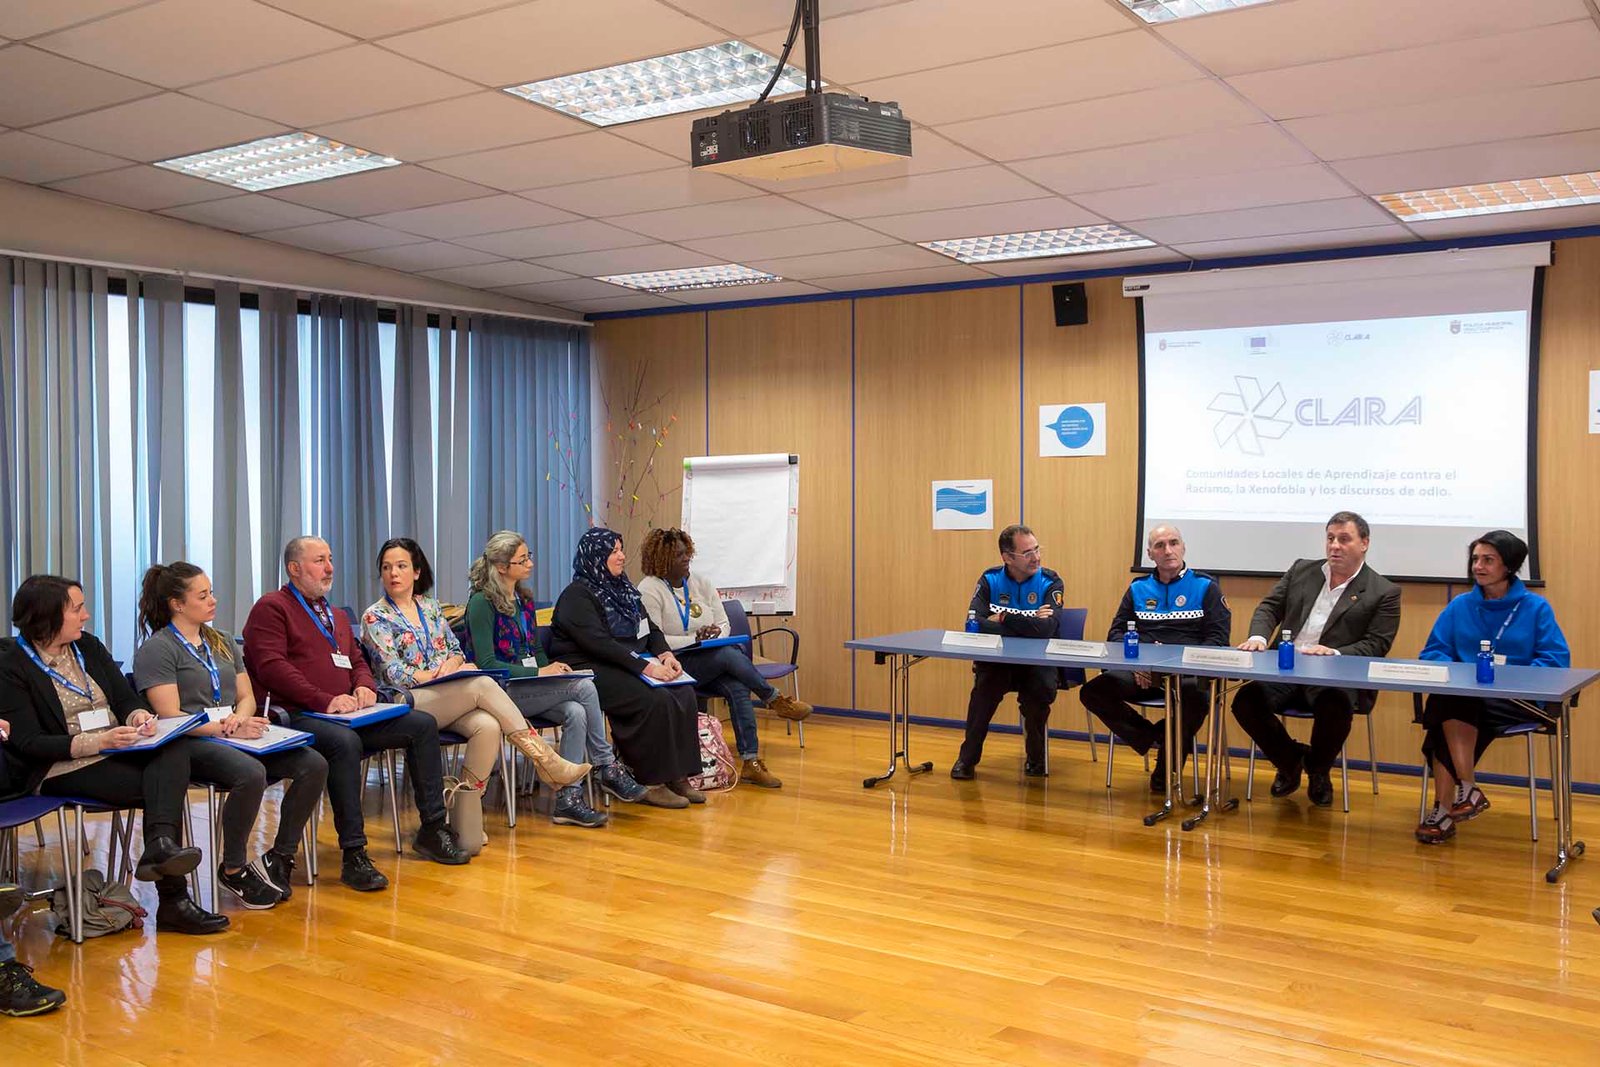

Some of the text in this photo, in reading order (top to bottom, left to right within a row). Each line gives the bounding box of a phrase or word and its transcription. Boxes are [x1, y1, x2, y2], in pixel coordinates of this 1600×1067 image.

[1295, 395, 1422, 427] CLARA
[1185, 468, 1457, 481] Comunidades Locales de Aprendizaje contra el
[1185, 483, 1453, 497] Racismo, la Xenofobia y los discursos de odio.
